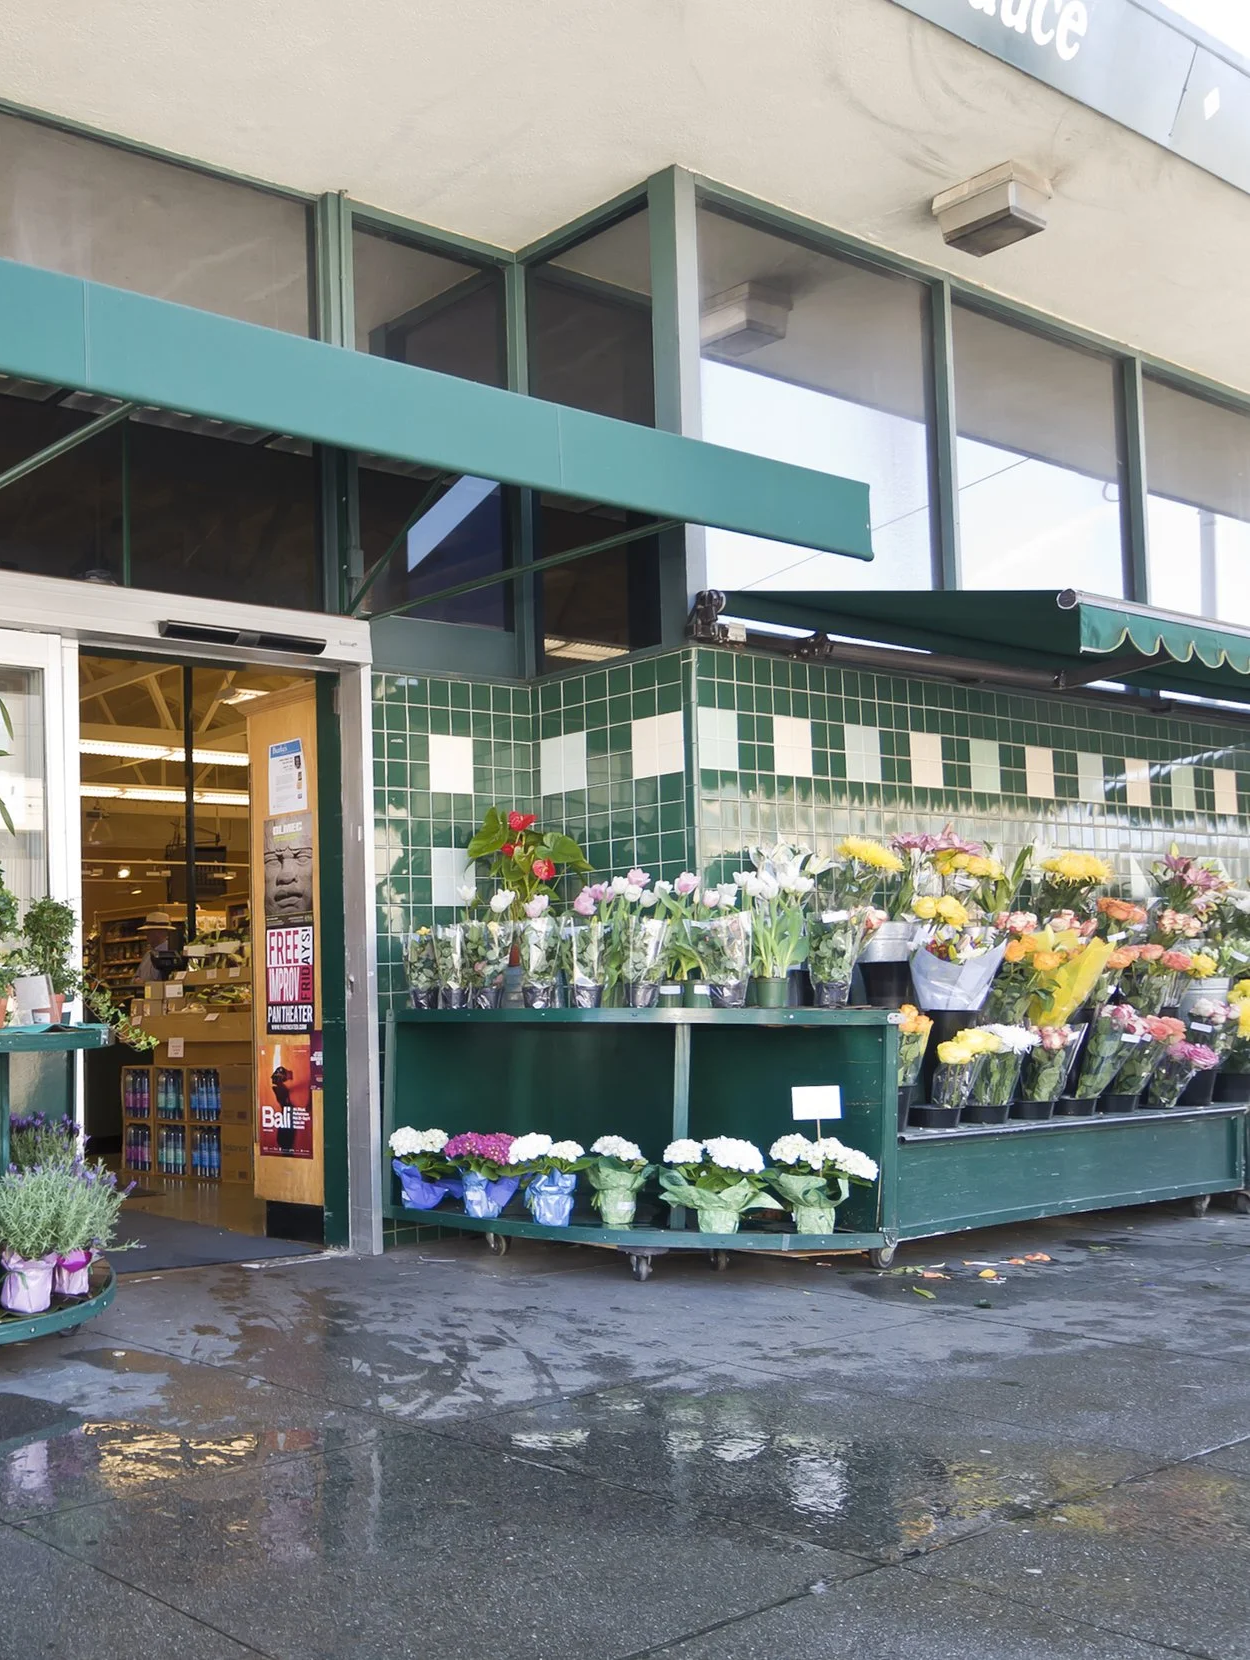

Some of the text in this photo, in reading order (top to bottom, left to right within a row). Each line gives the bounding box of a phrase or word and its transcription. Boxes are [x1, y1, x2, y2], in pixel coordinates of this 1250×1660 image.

[967, 0, 1088, 61] uce
[272, 821, 303, 836] OLMEC
[269, 929, 299, 965] FREE
[301, 928, 311, 1001] FRIDAYS!
[268, 966, 300, 1002] IMPROV
[261, 1105, 291, 1129] Bali
